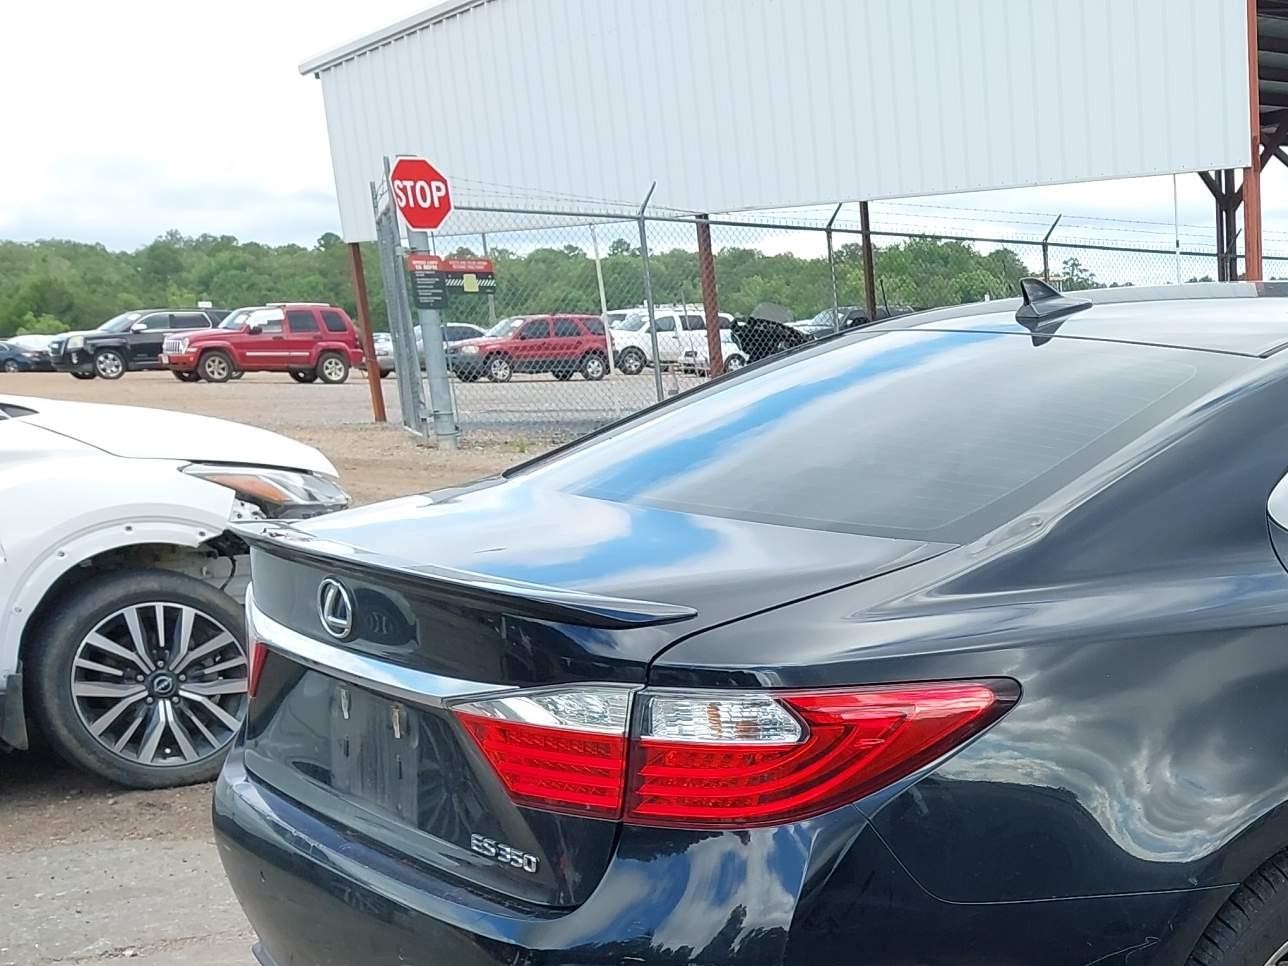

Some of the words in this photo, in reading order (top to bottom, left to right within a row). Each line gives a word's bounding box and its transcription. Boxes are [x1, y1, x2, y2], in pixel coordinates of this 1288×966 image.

[393, 180, 446, 208] STOP
[471, 833, 496, 856] ES
[497, 843, 536, 873] 350
